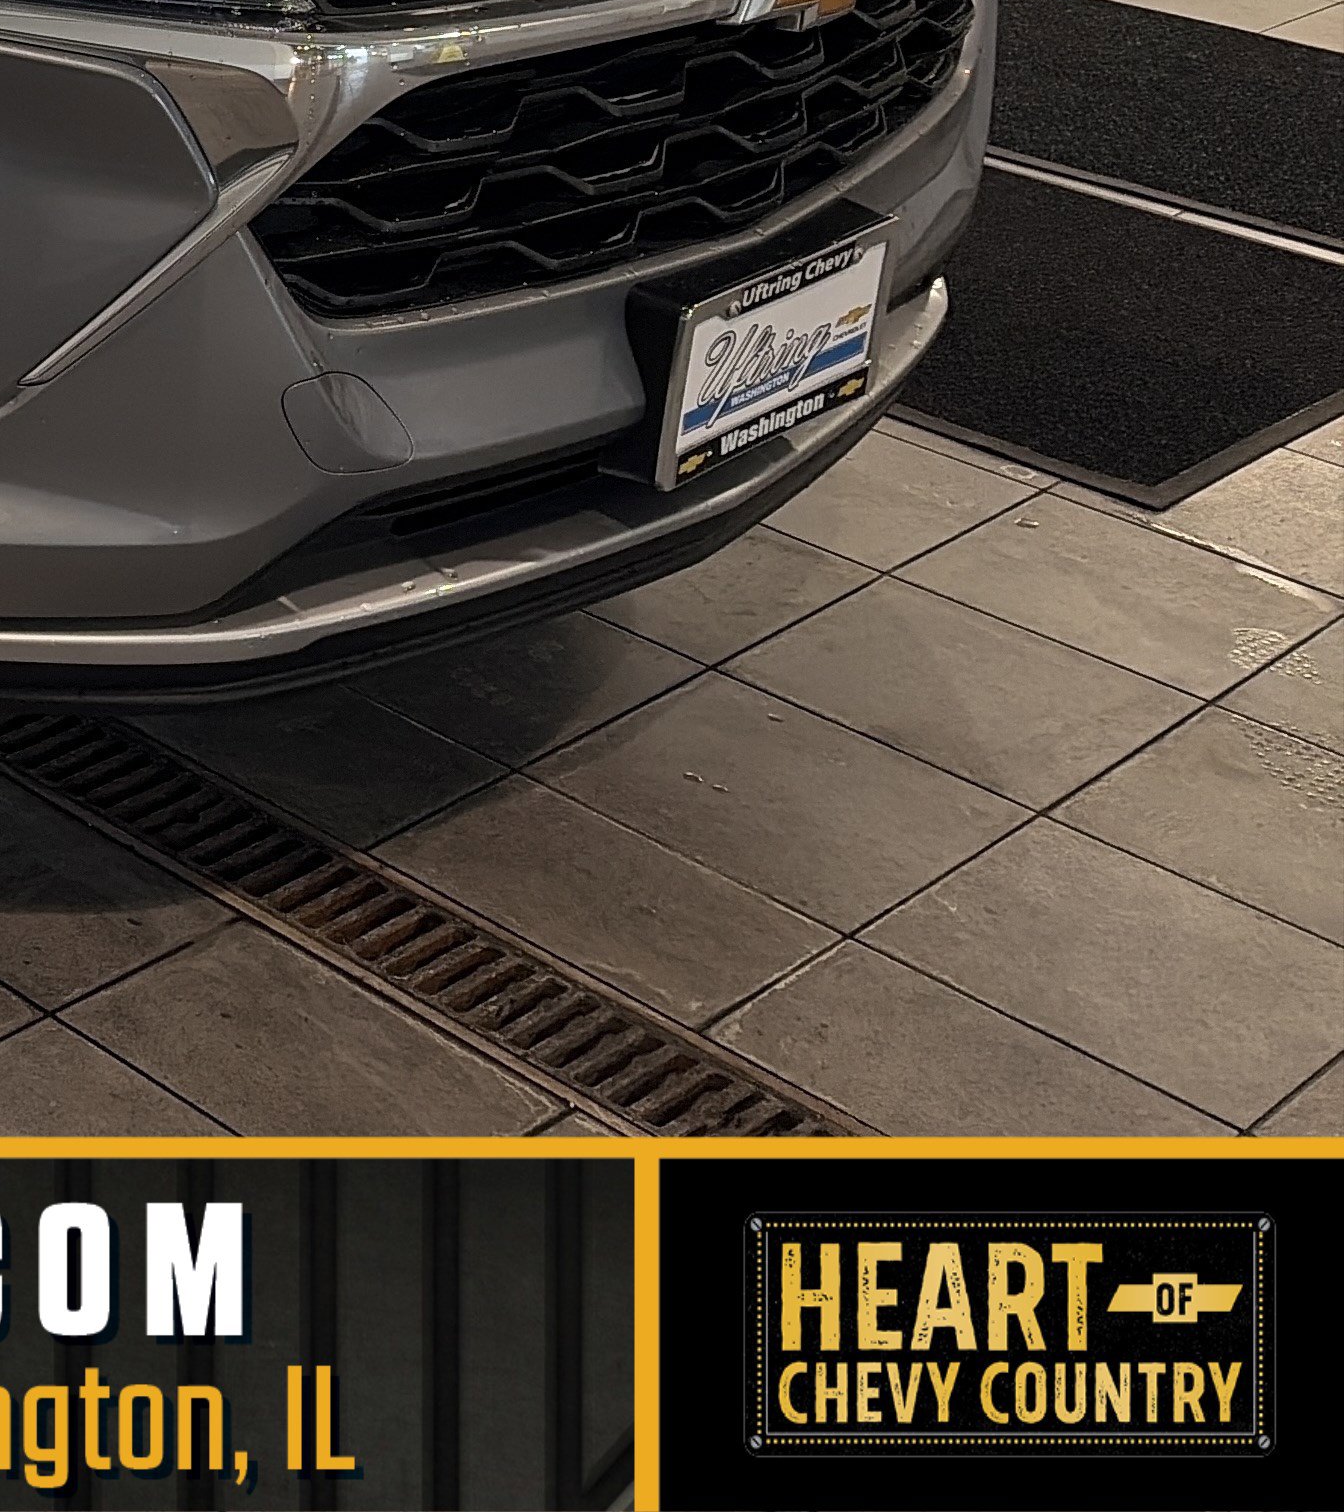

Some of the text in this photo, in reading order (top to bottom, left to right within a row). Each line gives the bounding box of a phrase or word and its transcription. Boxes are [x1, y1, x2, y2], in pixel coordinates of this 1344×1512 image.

[741, 245, 853, 308] Uftring Chevy
[730, 371, 790, 407] WASHINGTON
[720, 392, 825, 456] Washington
